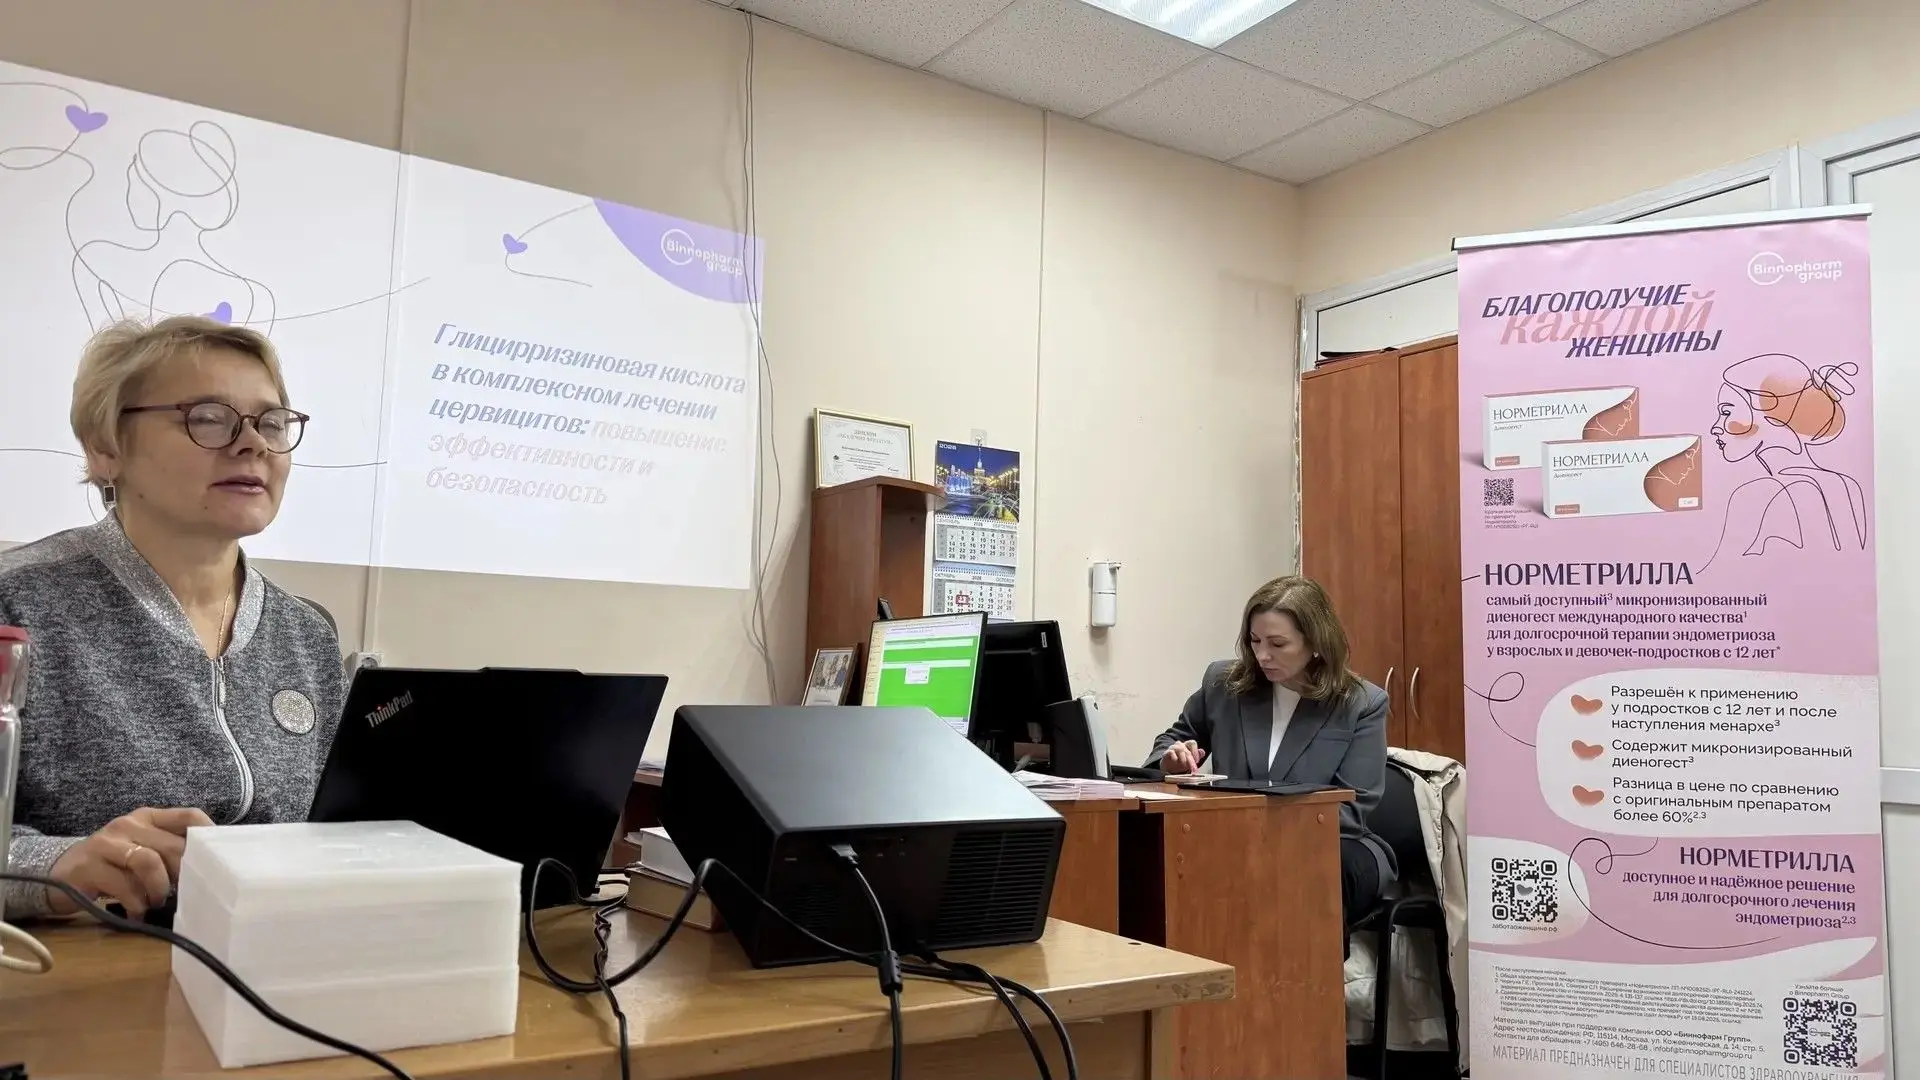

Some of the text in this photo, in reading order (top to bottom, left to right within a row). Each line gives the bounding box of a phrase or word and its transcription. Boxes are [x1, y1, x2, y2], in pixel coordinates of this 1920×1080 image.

[666, 239, 744, 266] Binnopharm
[707, 259, 743, 277] group
[1753, 260, 1842, 278] Binnopharm
[1798, 269, 1842, 283] group
[1482, 284, 1691, 318] БЛАГОПОЛУЧИЕ
[1500, 290, 1716, 345] каждой
[1565, 329, 1723, 358] ЖЕНЩИНЫ
[433, 323, 747, 393] Глицирризиновая кислота
[431, 363, 717, 420] в комплексном лечении
[1493, 403, 1588, 420] НОРМЕТРИЛЛА
[429, 398, 727, 454] цервицитов: повышение
[428, 433, 653, 476] эффективности и
[1553, 452, 1649, 468] НОРМЕТРИЛЛА
[425, 466, 607, 504] безопасность
[1485, 562, 1694, 586] НОРМЕТРИЛЛА
[1486, 593, 1531, 607] самый
[1616, 594, 1768, 608] микронизированный
[1486, 612, 1556, 625] диеногест
[1558, 613, 1676, 626] международного
[1487, 628, 1776, 643] для долгосрочной терапии эндометриоза
[1487, 646, 1496, 658] у
[1497, 646, 1562, 659] взрослых
[1565, 646, 1574, 657] и
[1576, 646, 1720, 660] девочек-подростков
[1724, 648, 1732, 658] с
[1735, 646, 1749, 659] 12
[1611, 685, 1799, 702] Разрешён к применению
[364, 689, 414, 728] ThinkPad
[1611, 704, 1837, 718] у подростков с 12 лет и после
[1612, 720, 1704, 732] наступления
[1612, 740, 1852, 758] Содержит микронизированный
[1613, 777, 1839, 797] Разница в цене по сравнению
[1613, 795, 1831, 812] с оригинальным препаратом
[1613, 810, 1658, 822] более
[1680, 846, 1855, 873] НОРМЕТРИЛЛА
[1623, 870, 1856, 894] доступное и надёжное решение
[1653, 890, 1856, 913] для долгосрочного лечения
[1493, 1016, 1528, 1025] Материал
[1577, 1023, 1617, 1032] поддержке
[1493, 1024, 1514, 1032] Адрес
[1493, 1031, 1526, 1040] Контакты
[1492, 1045, 1547, 1062] МАТЕРИАЛ
[1549, 1049, 1630, 1069] ПРЕДНАЗНАЧЕН
[1634, 1057, 1656, 1072] ДЛЯ
[1659, 1059, 1746, 1079] СПЕЦИАЛИСТОВ
